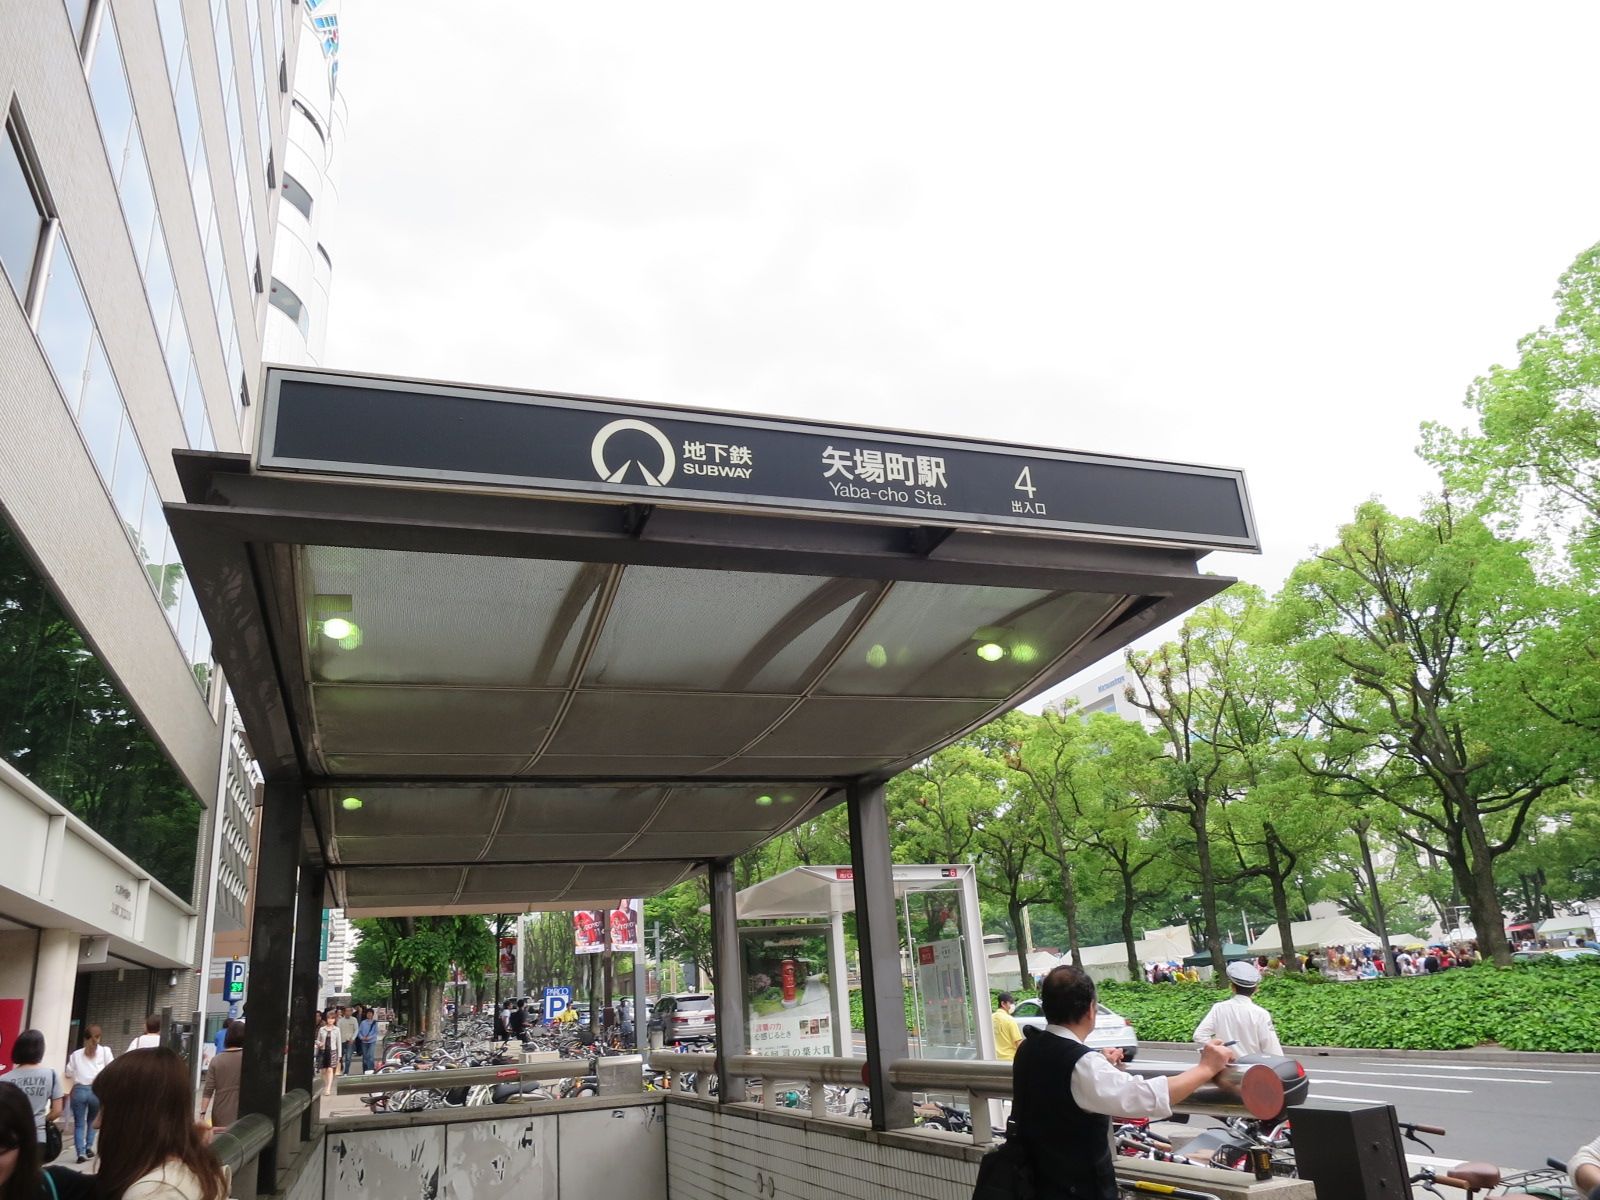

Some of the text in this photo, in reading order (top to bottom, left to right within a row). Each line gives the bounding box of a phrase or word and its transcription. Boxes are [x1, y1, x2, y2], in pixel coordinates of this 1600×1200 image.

[683, 441, 752, 466] 地下鉄
[683, 463, 753, 480] SUBWAY
[821, 446, 948, 489] 矢場町駅
[1014, 465, 1037, 499] 4
[828, 481, 947, 506] Yaba-cho Sta.
[1011, 500, 1047, 516] 出入口
[233, 964, 243, 981] P
[546, 987, 569, 996] PARCO
[549, 997, 565, 1017] P
